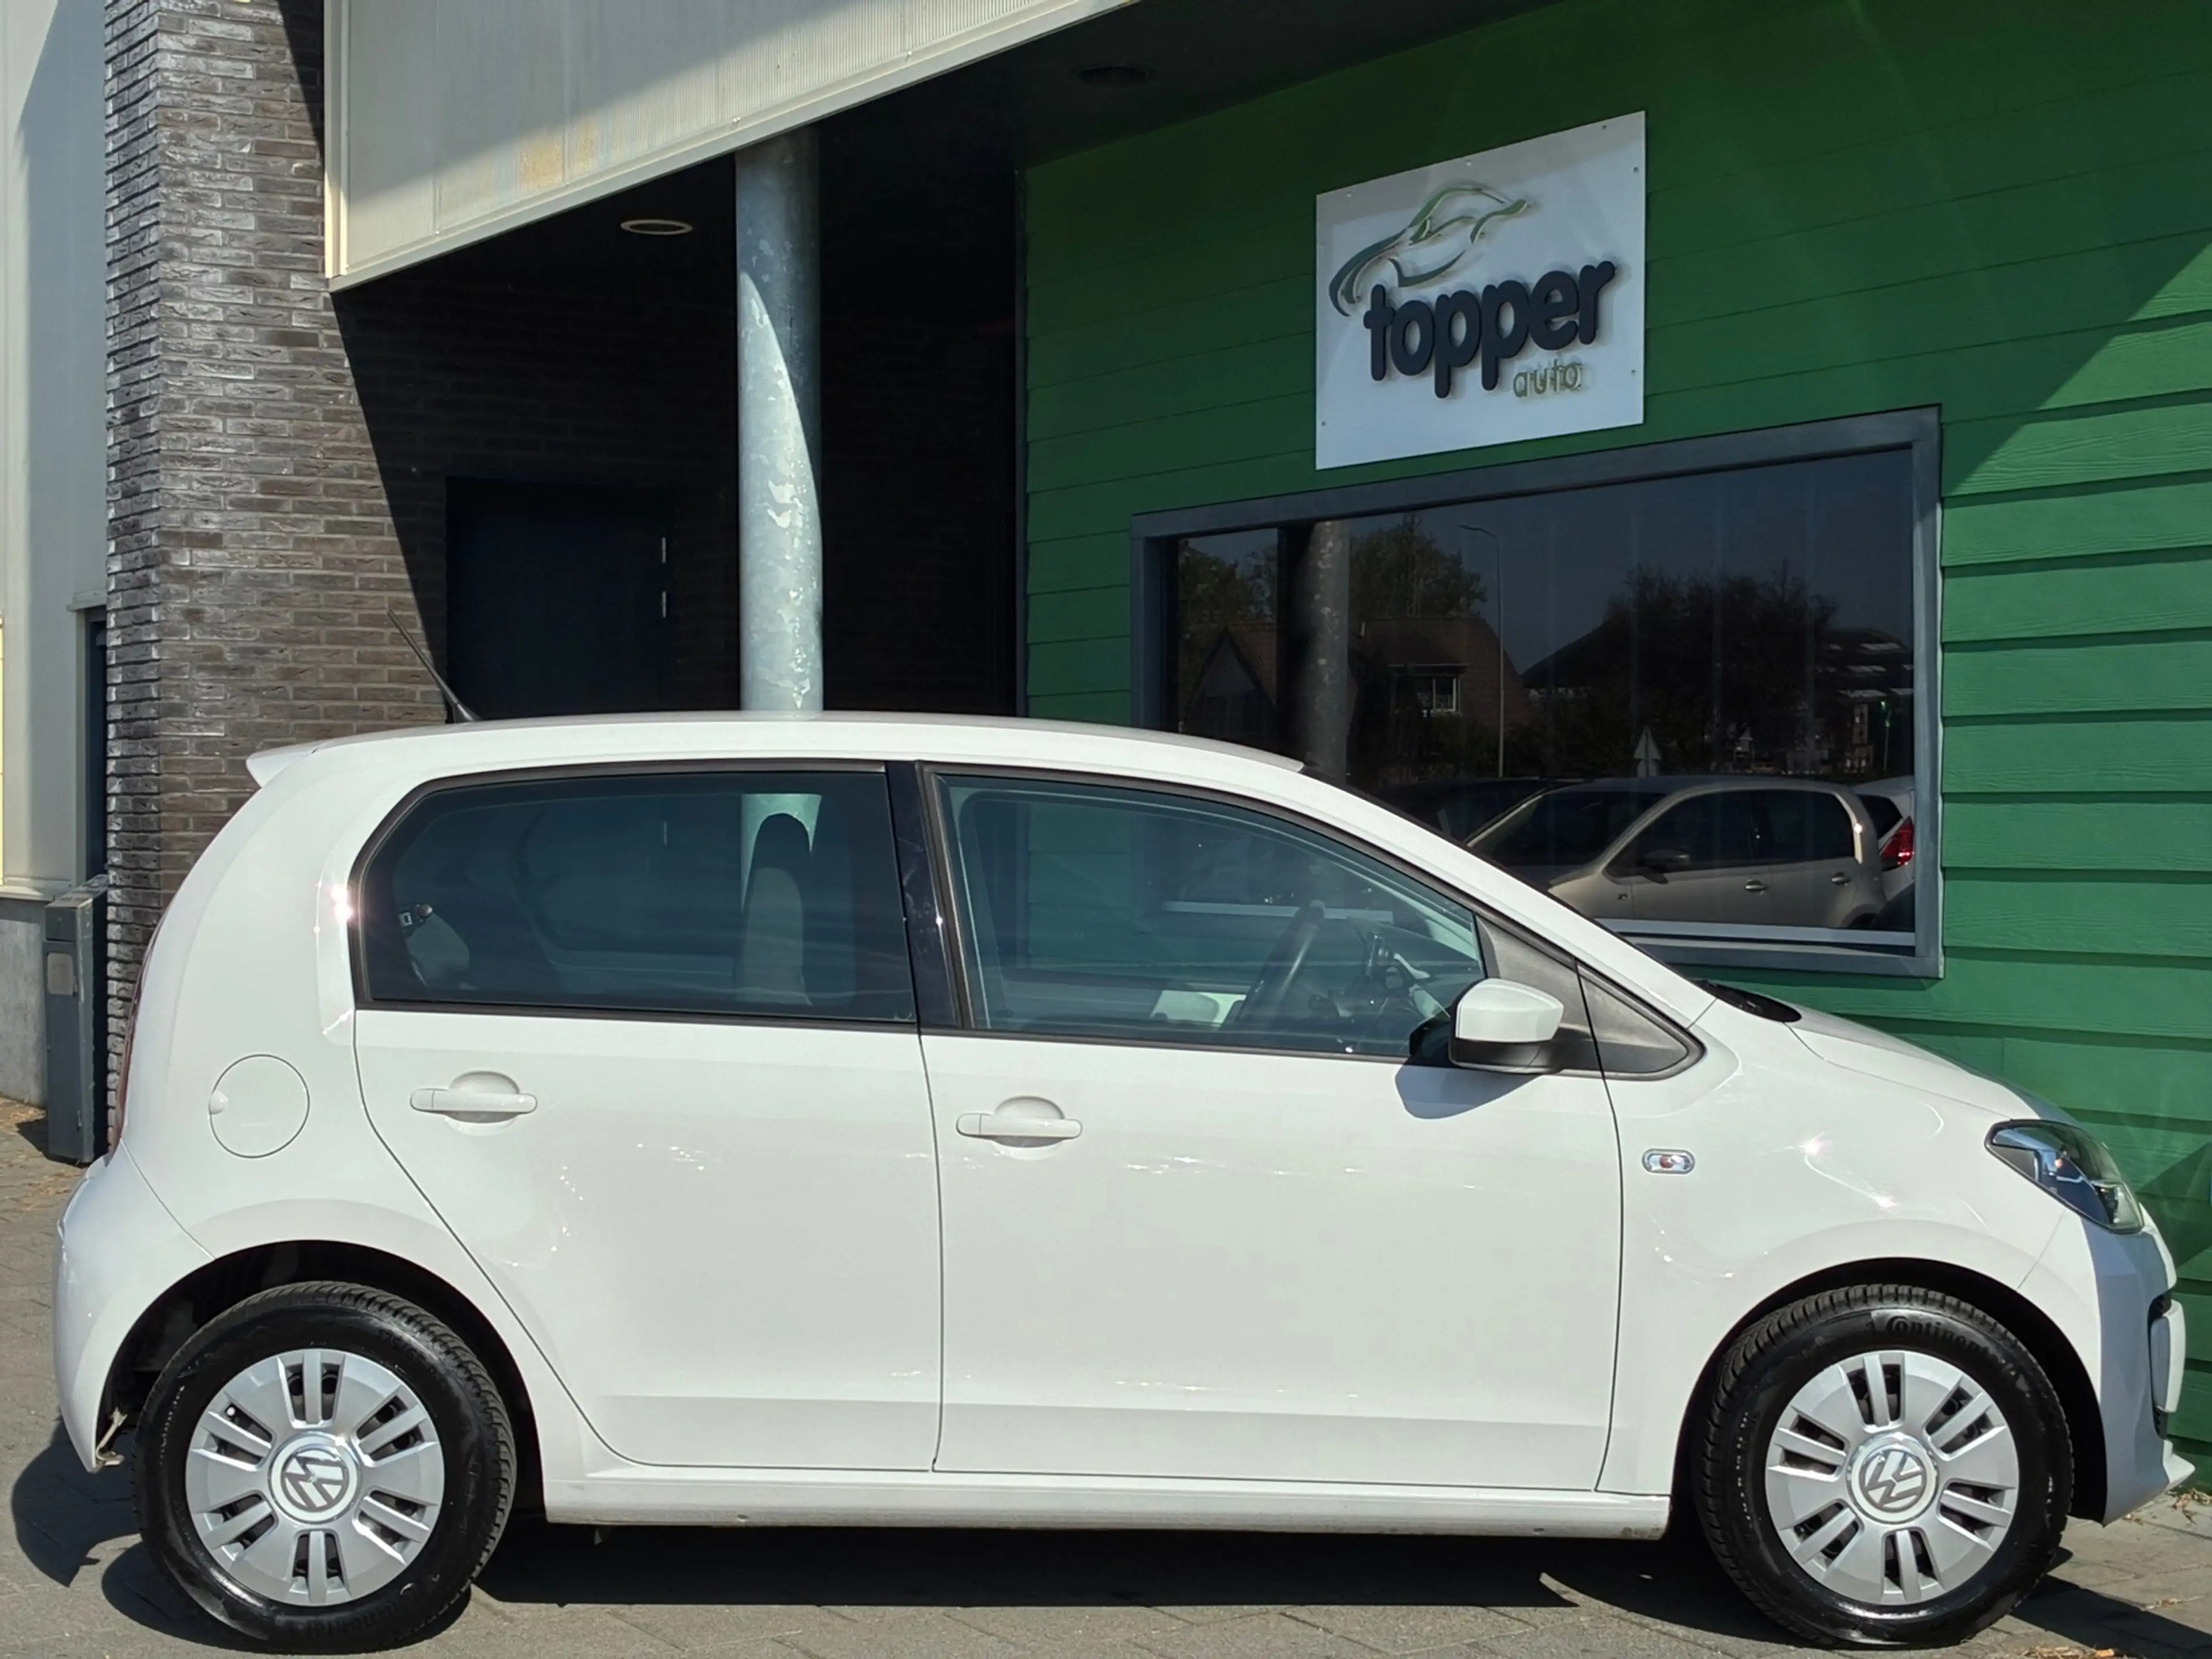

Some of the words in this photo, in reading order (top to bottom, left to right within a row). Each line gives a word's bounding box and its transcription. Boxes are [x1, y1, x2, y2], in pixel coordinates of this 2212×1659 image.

[1363, 260, 1616, 399] topper
[1512, 359, 1583, 399] auto
[1885, 1314, 1999, 1365] Continent
